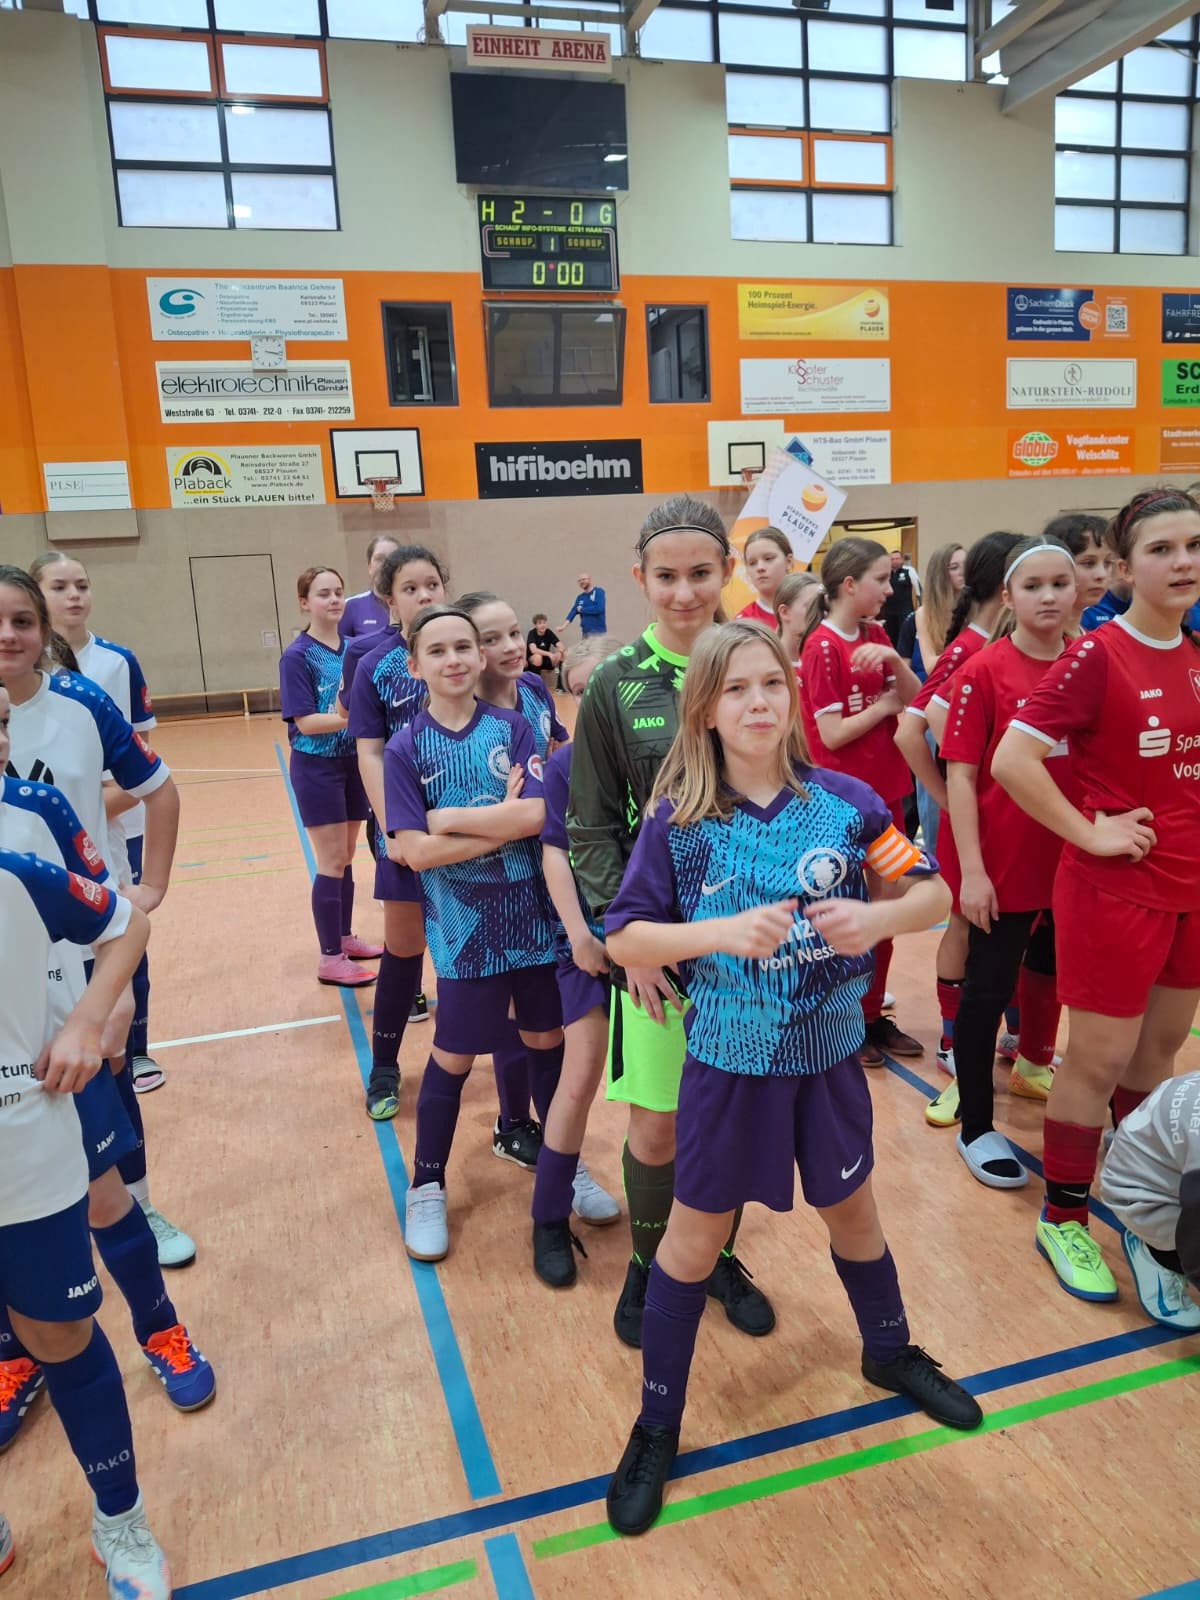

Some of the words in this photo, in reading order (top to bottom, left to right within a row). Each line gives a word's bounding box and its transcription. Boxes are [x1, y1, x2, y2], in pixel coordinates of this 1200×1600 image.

[472, 36, 540, 57] EINHEIT
[552, 41, 606, 61] ARENA
[481, 200, 494, 221] H
[511, 200, 525, 223] 2
[570, 201, 583, 225] 0
[599, 204, 612, 225] G
[748, 291, 762, 299] 100
[763, 291, 793, 299] Prozent
[317, 384, 349, 392] GmbH
[165, 408, 204, 417] Weststraße
[205, 408, 215, 416] 63
[224, 408, 235, 416] Tel.
[263, 407, 282, 416] 212-0
[292, 407, 304, 415] Fax
[327, 406, 351, 415] 212259
[489, 453, 632, 482] hifiboehm
[173, 476, 233, 491] Plaback
[212, 495, 241, 504] Stück
[245, 494, 285, 503] PLAUEN
[288, 493, 315, 502] bitte!
[781, 511, 817, 538] PLAUEN
[1139, 688, 1163, 700] JAKO
[633, 716, 665, 729] JAKO
[759, 954, 794, 972] von
[1169, 1077, 1200, 1145] Verband
[67, 1274, 98, 1299] JAKO
[87, 1448, 130, 1475] JAKO
